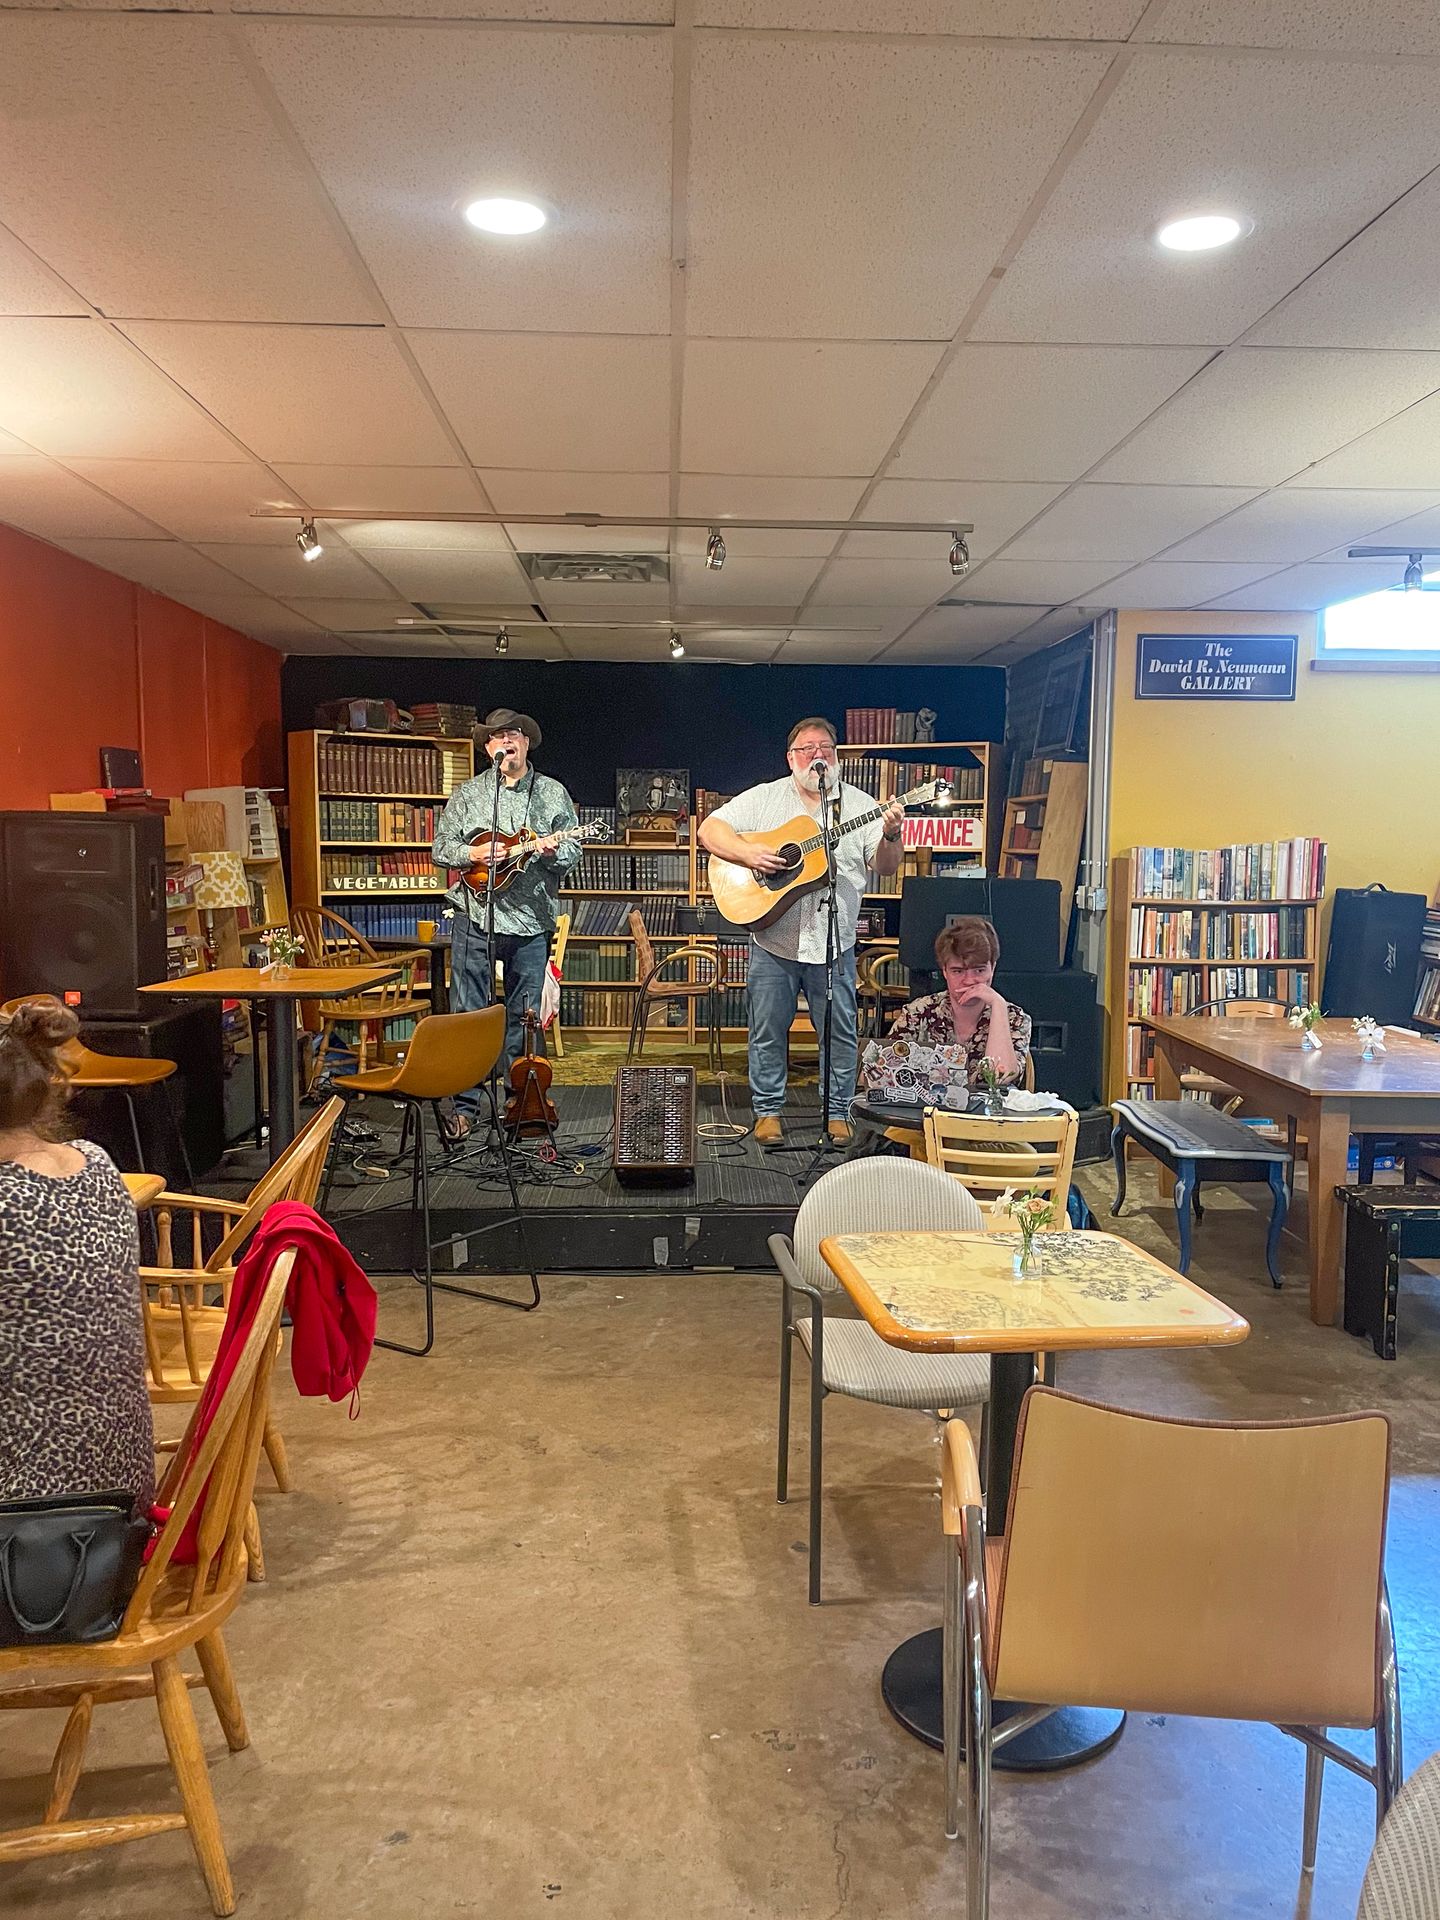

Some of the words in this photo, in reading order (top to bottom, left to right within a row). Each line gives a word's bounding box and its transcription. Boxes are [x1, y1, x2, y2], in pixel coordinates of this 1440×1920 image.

[1205, 642, 1233, 657] The
[1149, 659, 1194, 673] David
[1196, 659, 1213, 673] R.
[1216, 660, 1286, 674] Neumann
[1180, 676, 1256, 690] GALLERY
[333, 877, 438, 889] VEGETABLES
